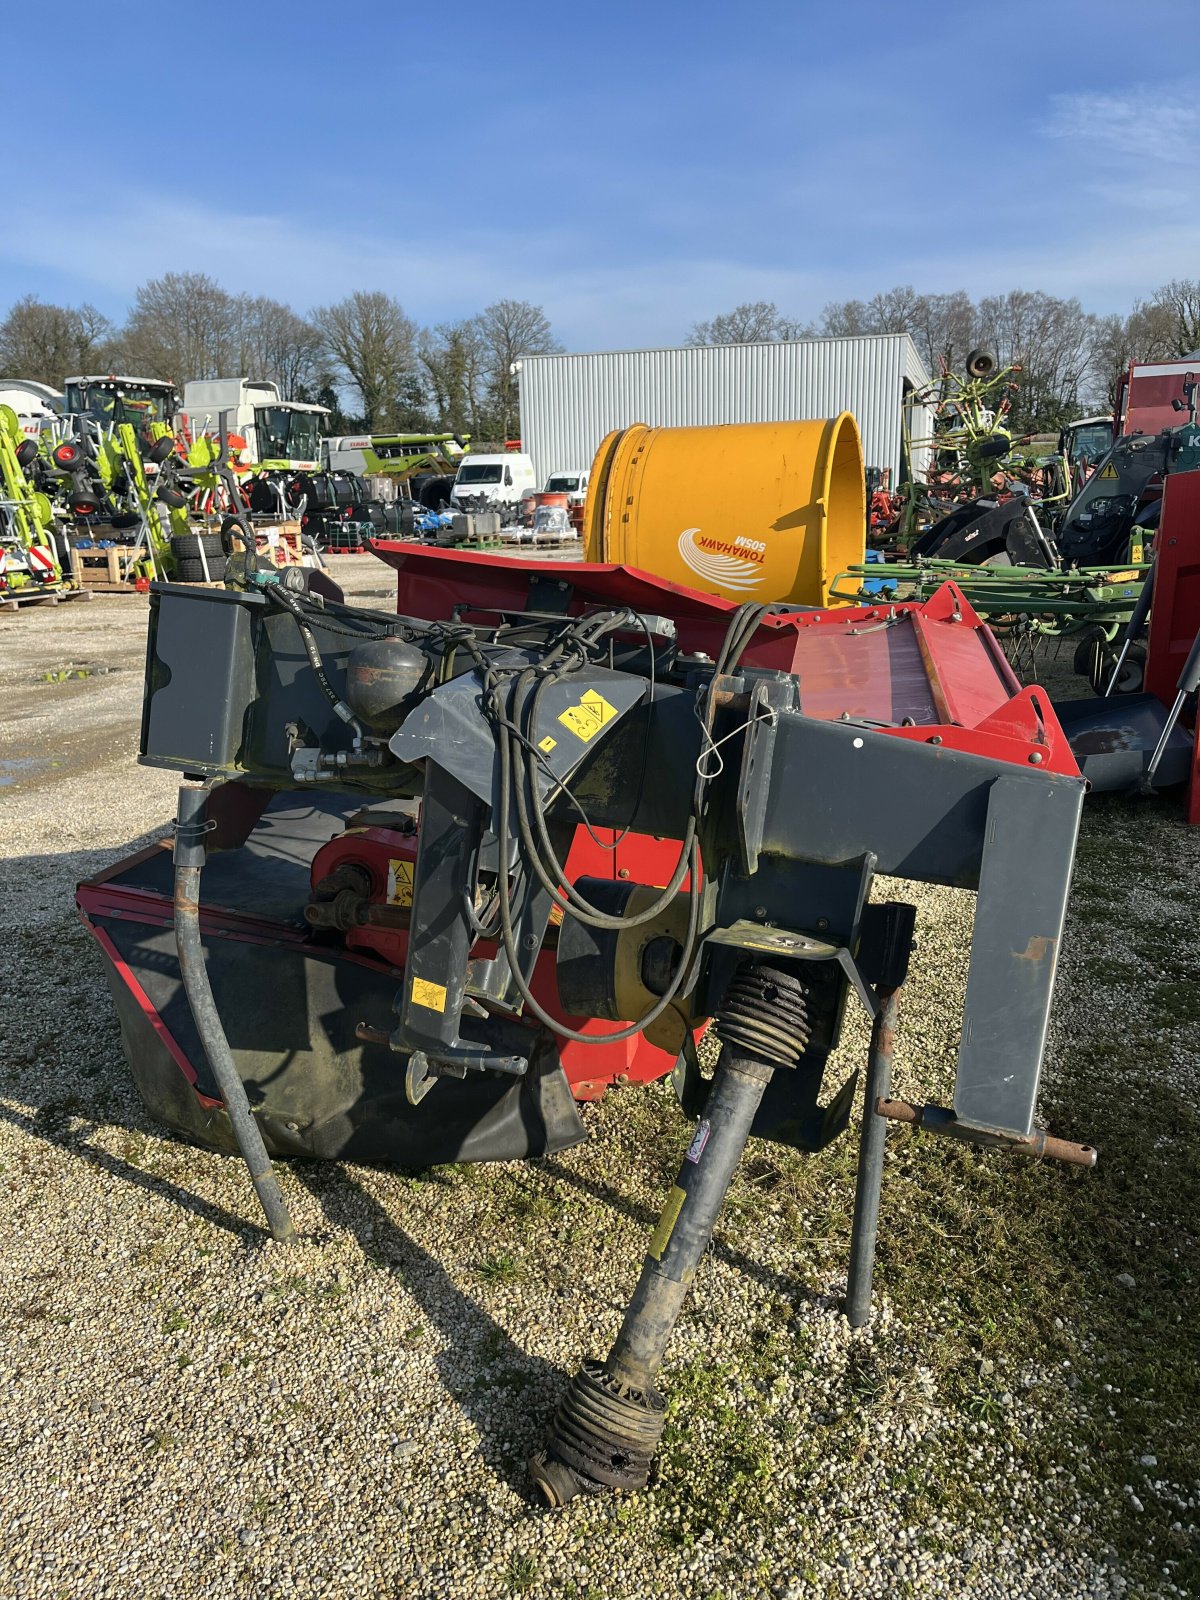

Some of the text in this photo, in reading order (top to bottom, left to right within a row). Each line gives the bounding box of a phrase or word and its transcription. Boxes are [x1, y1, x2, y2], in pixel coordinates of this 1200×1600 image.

[698, 536, 766, 564] TOMAHAWK
[734, 535, 767, 553] 505M
[312, 656, 321, 668] DN
